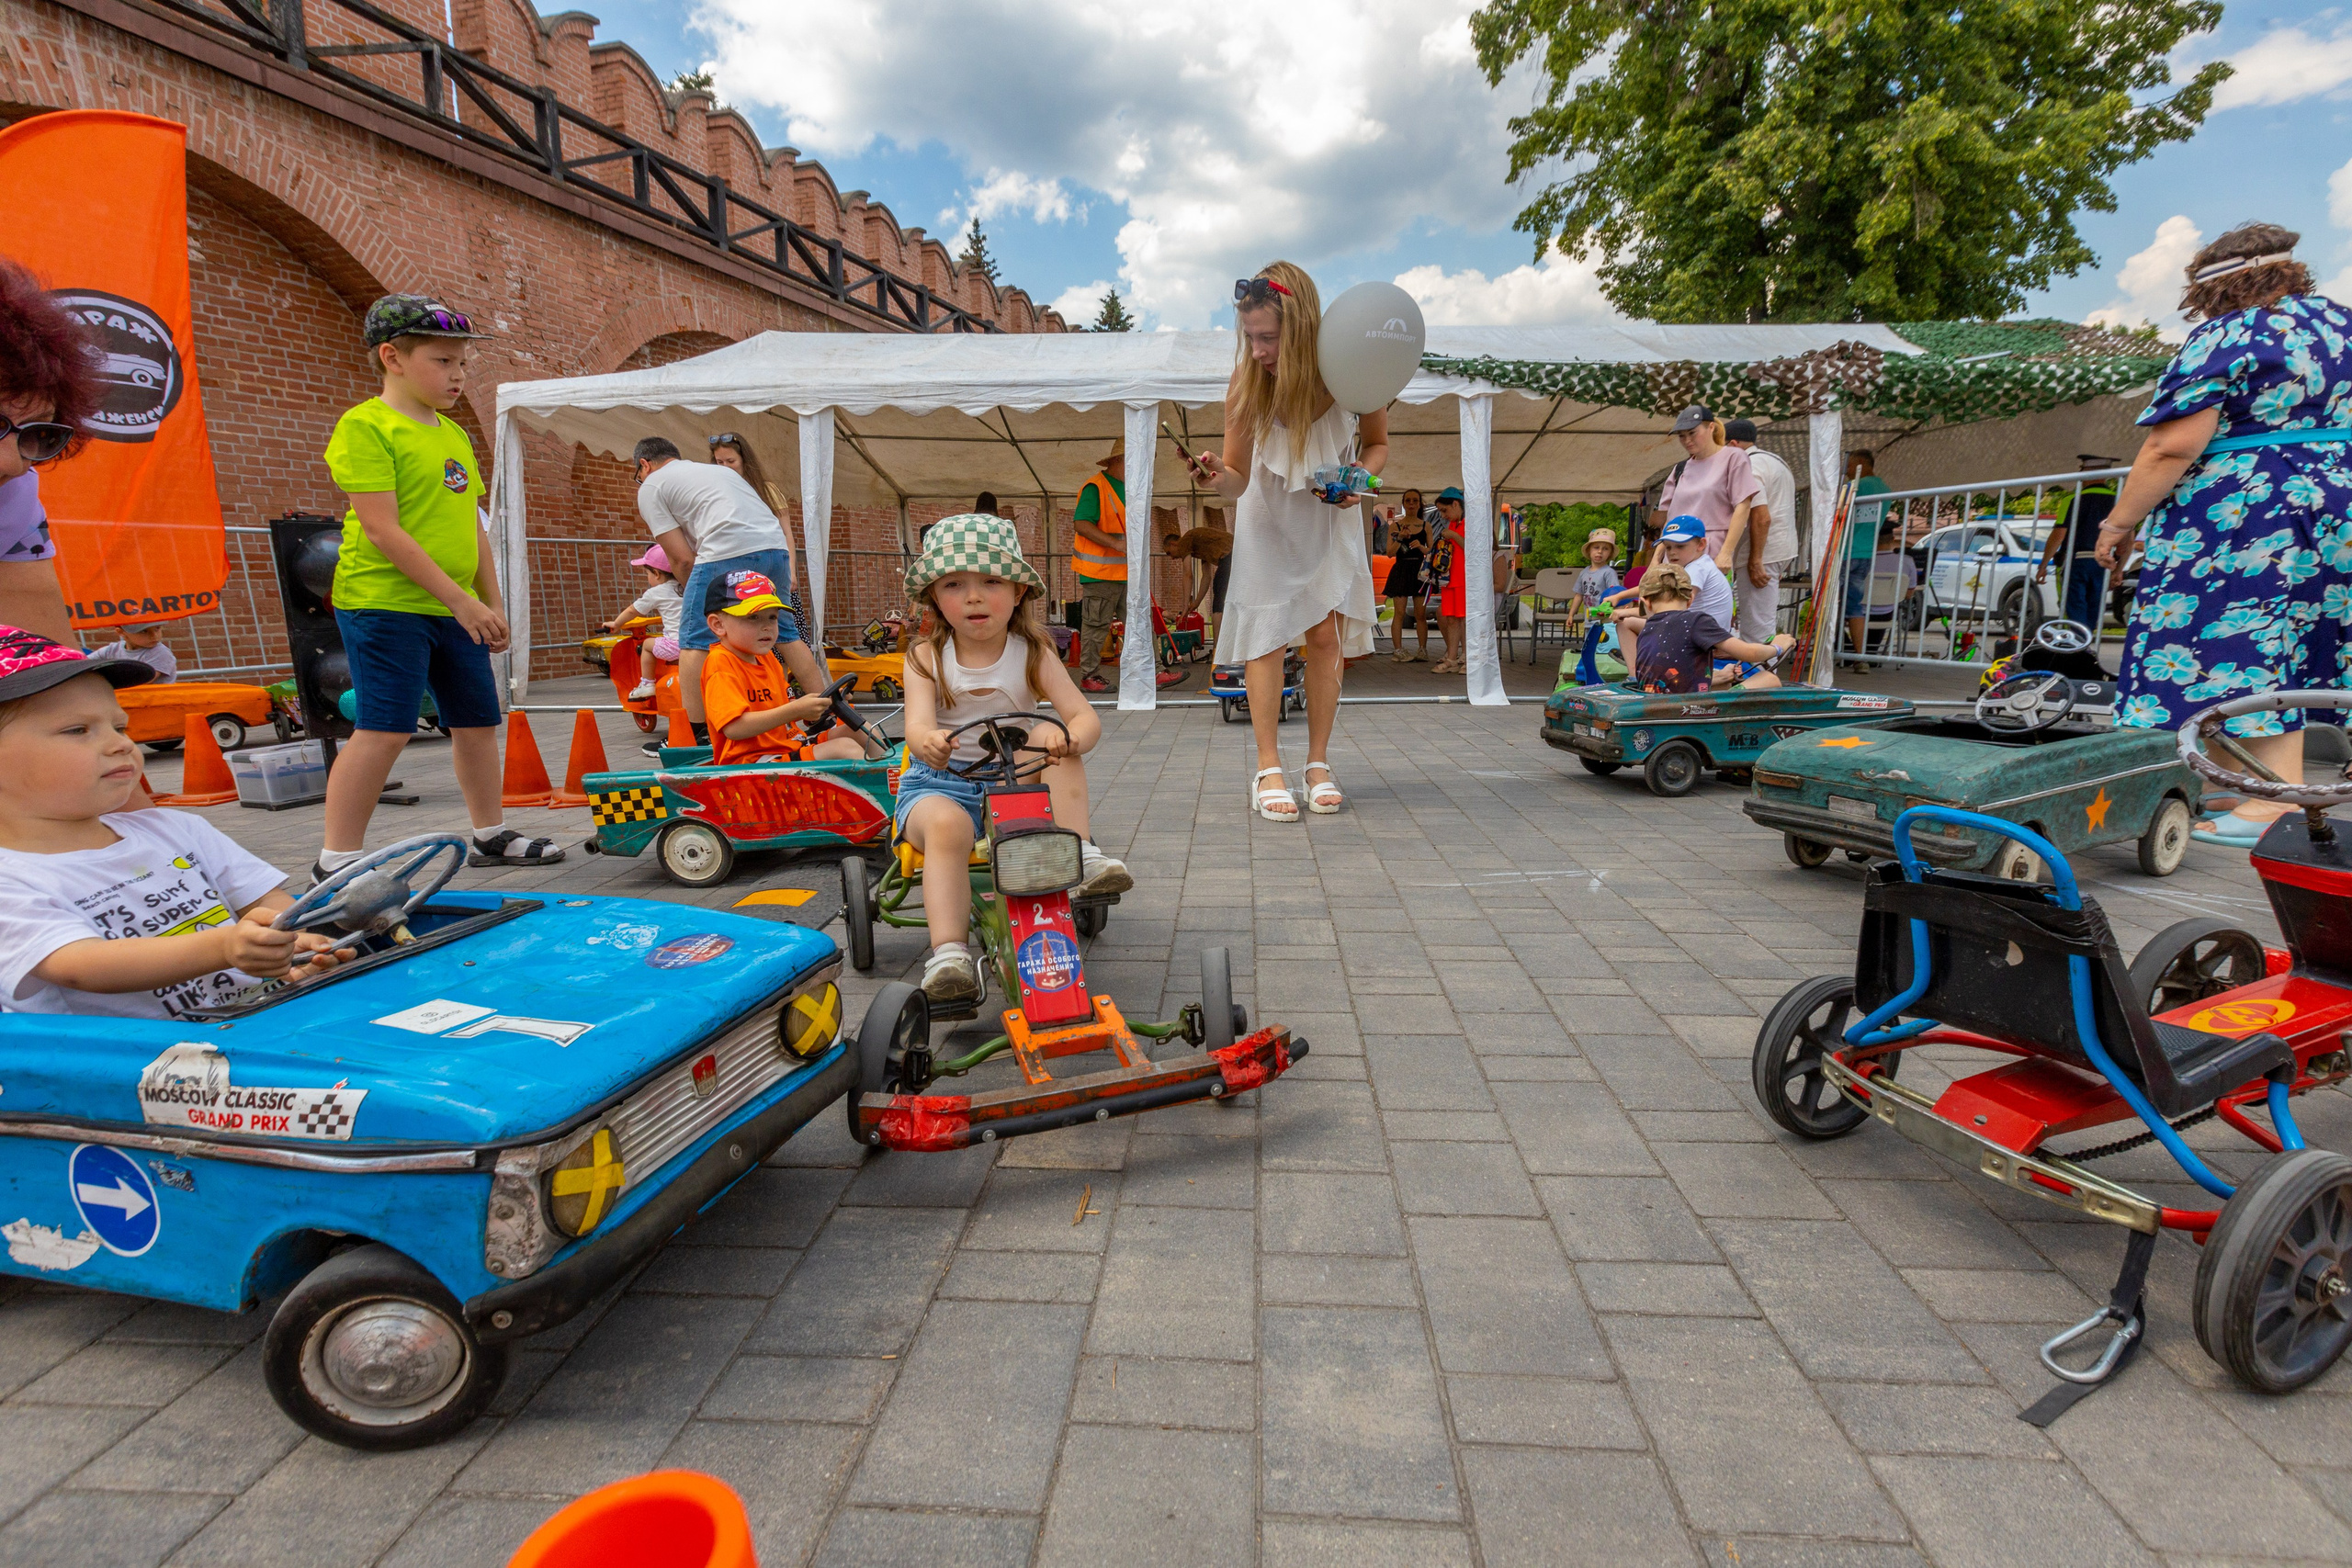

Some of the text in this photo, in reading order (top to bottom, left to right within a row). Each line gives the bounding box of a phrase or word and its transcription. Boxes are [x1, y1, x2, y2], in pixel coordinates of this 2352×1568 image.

[1365, 331, 1416, 343] АВТОИМПОРТ
[1018, 958, 1046, 969] ГАРАЖА
[1047, 953, 1080, 964] ОСОБОГО
[1026, 963, 1075, 975] НАЗНАЧЕНИЯ
[144, 1088, 297, 1111] MOSCOW CLASSIC
[187, 1108, 290, 1132] GRAND PRIX
